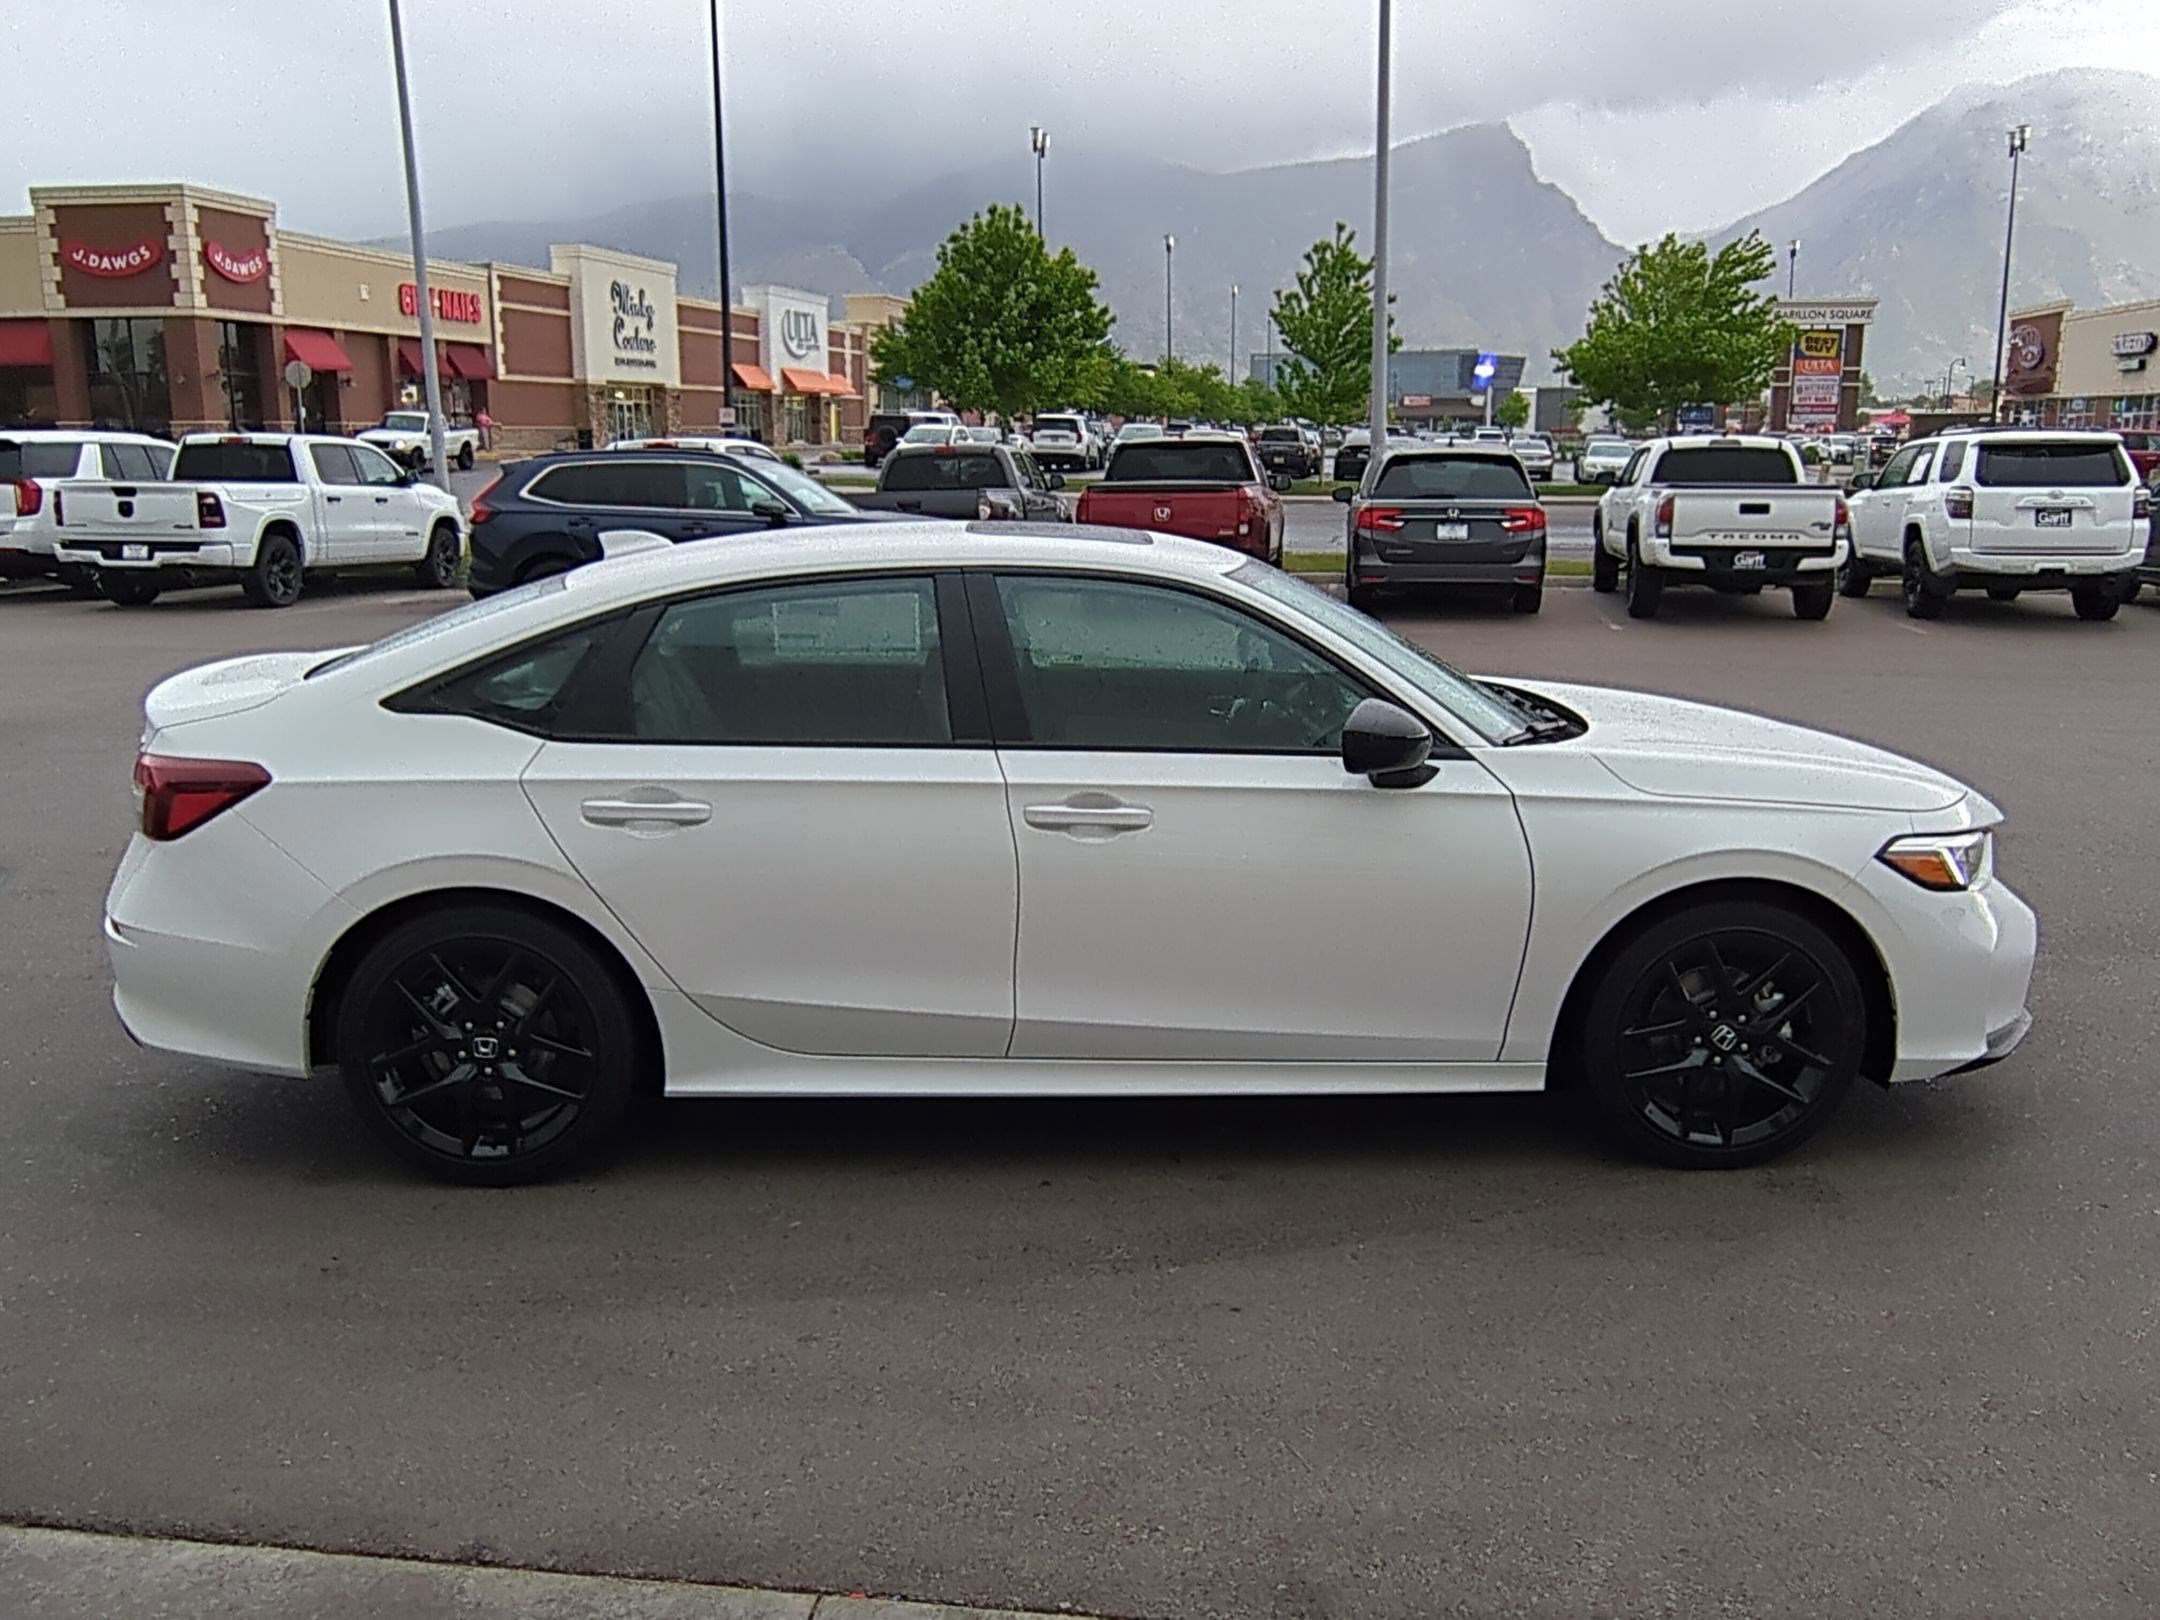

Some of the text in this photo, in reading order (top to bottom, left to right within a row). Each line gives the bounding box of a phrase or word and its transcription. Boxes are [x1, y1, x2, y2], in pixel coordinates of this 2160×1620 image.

[72, 245, 151, 270] J.DAWGS
[214, 250, 263, 276] J.DAWGS
[1829, 309, 1873, 320] SQUARE
[784, 309, 818, 345] ULTA
[1805, 335, 1838, 346] BEST
[1805, 344, 1834, 354] BUY
[1708, 533, 1800, 541] TACOMA
